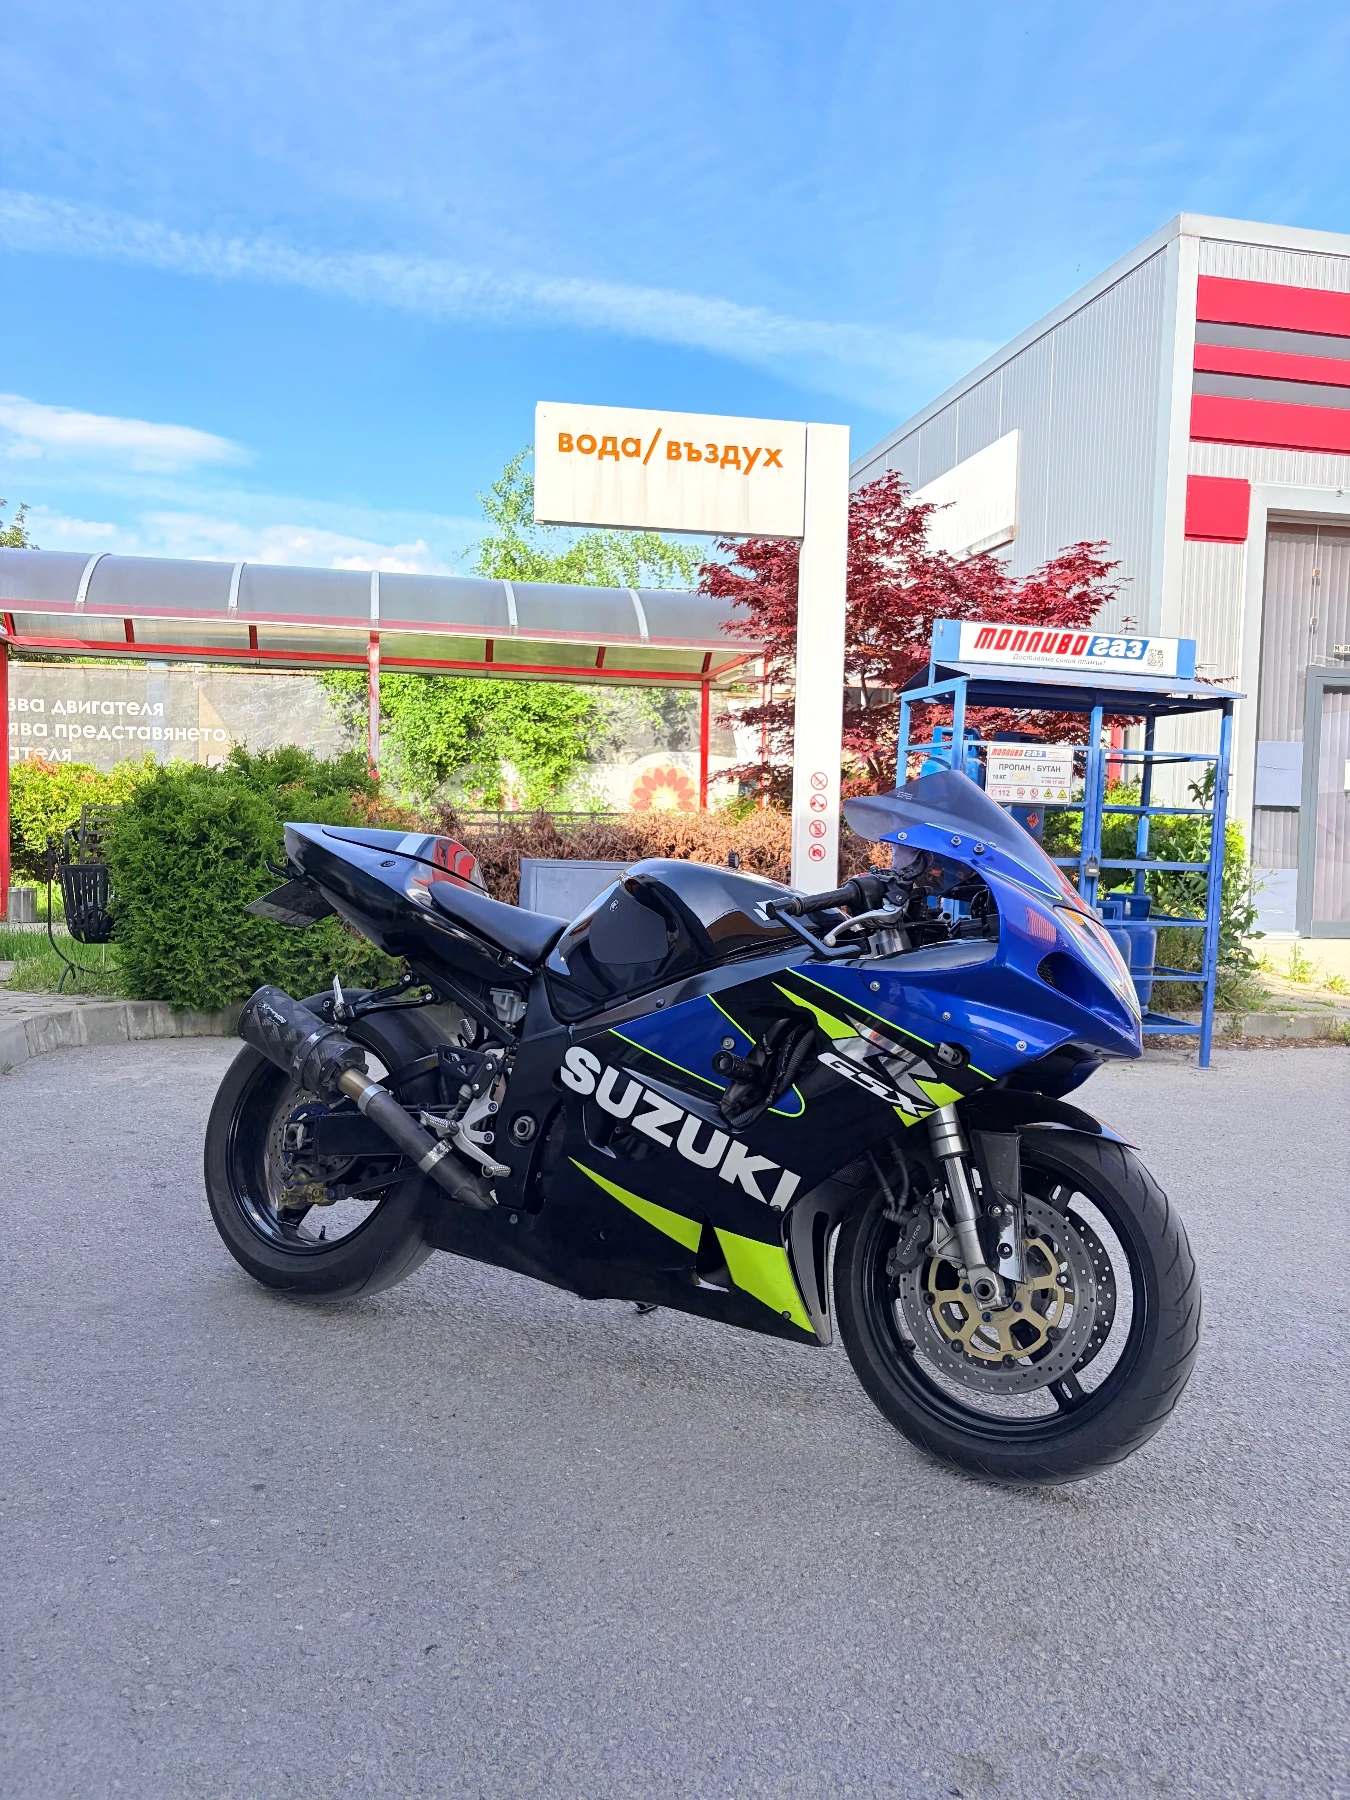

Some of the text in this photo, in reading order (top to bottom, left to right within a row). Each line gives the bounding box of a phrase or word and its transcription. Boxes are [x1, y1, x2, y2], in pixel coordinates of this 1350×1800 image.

[51, 699, 164, 717] двигателя
[55, 723, 227, 743] представянето
[998, 763, 1031, 772] ПРОПАН
[1036, 765, 1061, 773] БУТАН
[998, 789, 1010, 797] 112
[817, 1052, 935, 1116] GSX
[560, 1045, 801, 1212] SUZUKI
[902, 1224, 921, 1256] TOKICO
